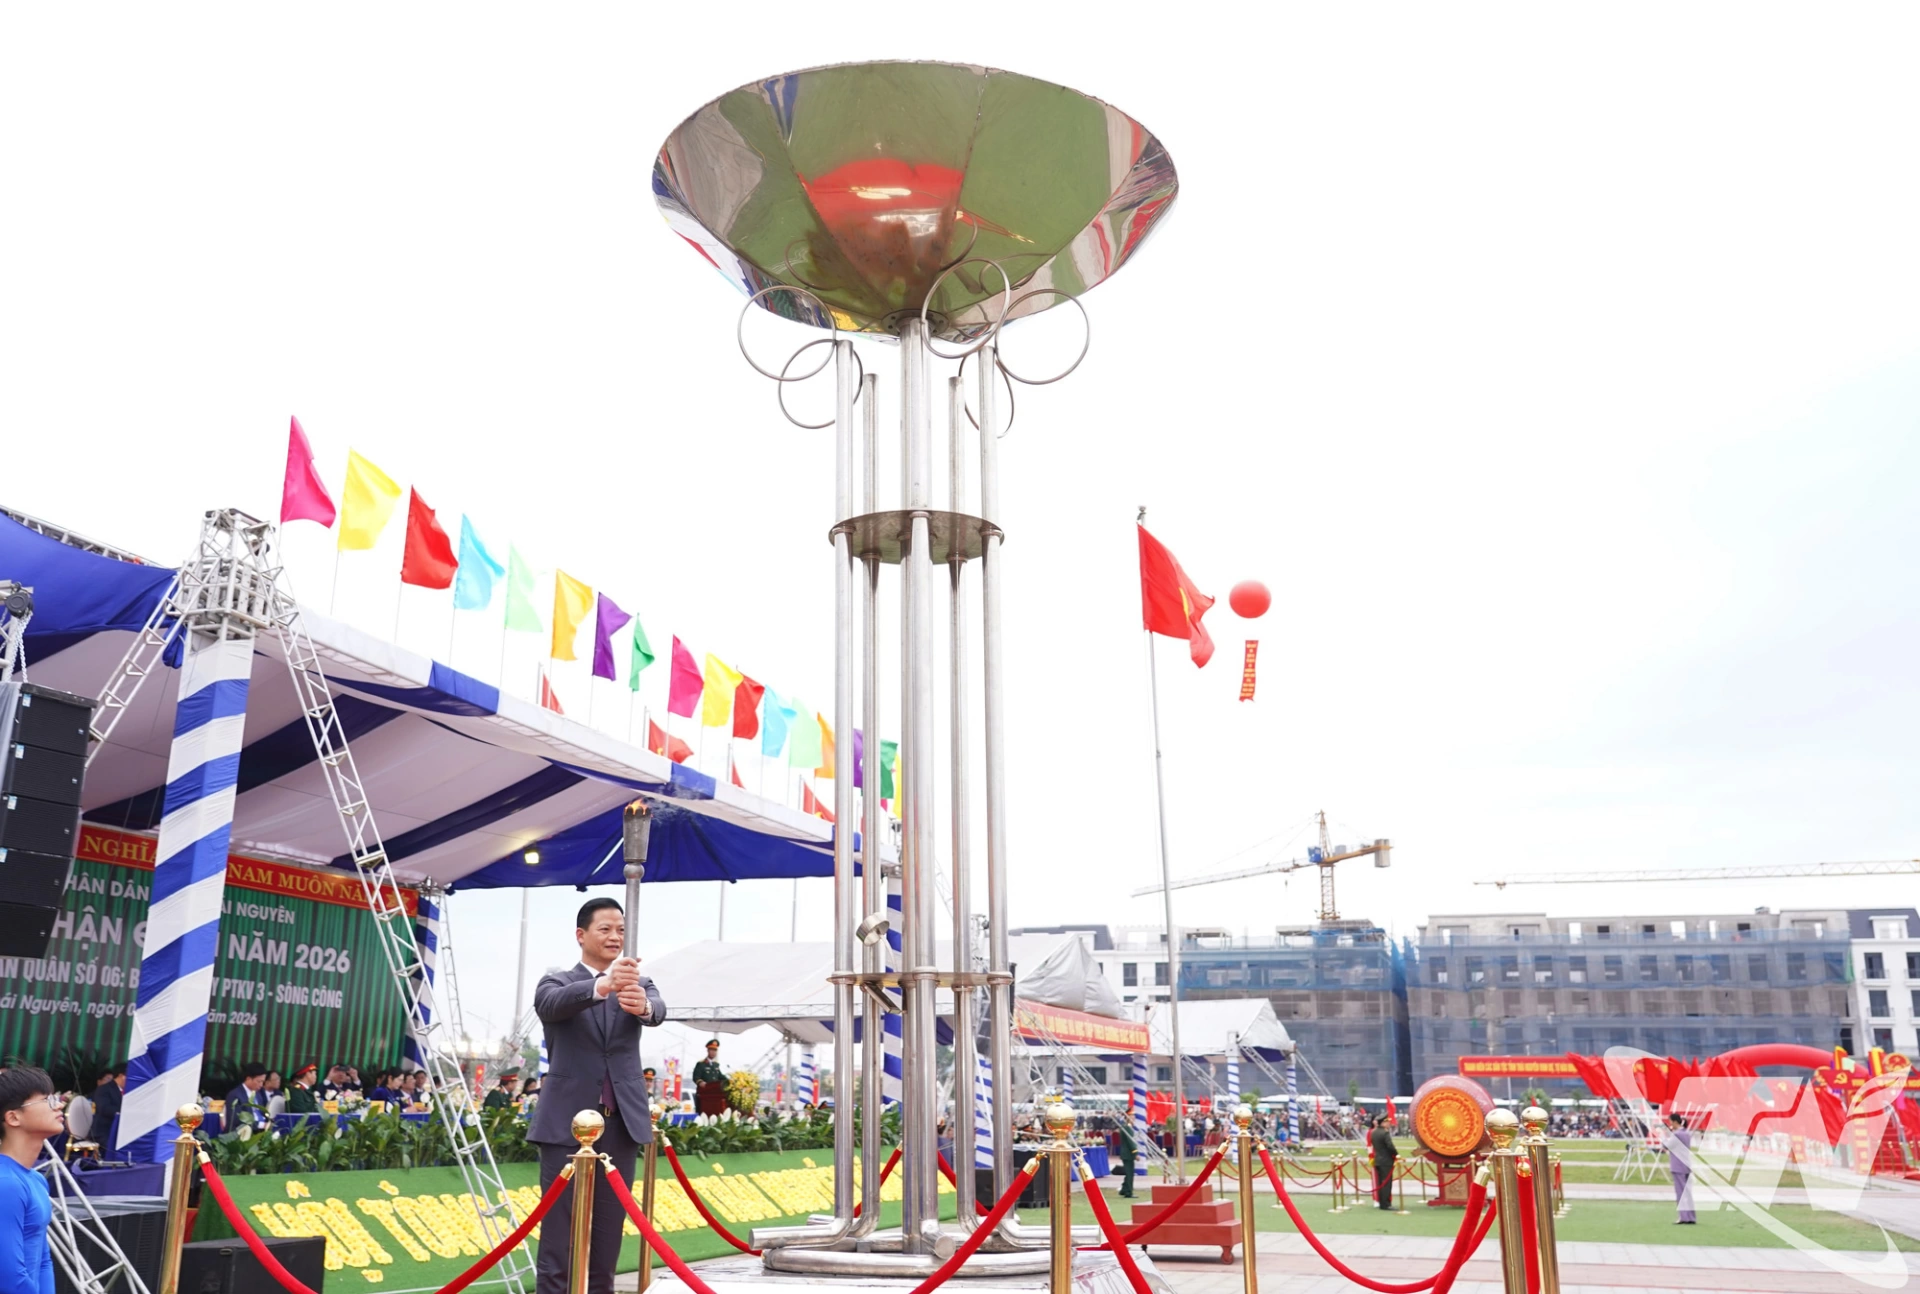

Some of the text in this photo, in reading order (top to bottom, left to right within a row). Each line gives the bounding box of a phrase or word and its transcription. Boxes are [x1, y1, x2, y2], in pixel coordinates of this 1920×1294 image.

[110, 879, 149, 902] DÂN
[227, 863, 273, 886] NAM
[278, 872, 335, 897] MUÔN
[236, 902, 295, 925] NGUYÊN
[228, 930, 288, 967] NĂM
[294, 943, 351, 974] 2026
[23, 956, 70, 983] QUÂN
[74, 957, 99, 985] SỐ
[101, 965, 125, 988] 06:
[19, 994, 82, 1016] Nguyên,
[86, 1000, 125, 1019] ngày
[222, 977, 255, 1001] PTKV
[256, 981, 266, 1002] 3
[275, 982, 309, 1006] SÔNG
[311, 985, 343, 1009] CÔNG
[228, 1010, 258, 1026] 2026
